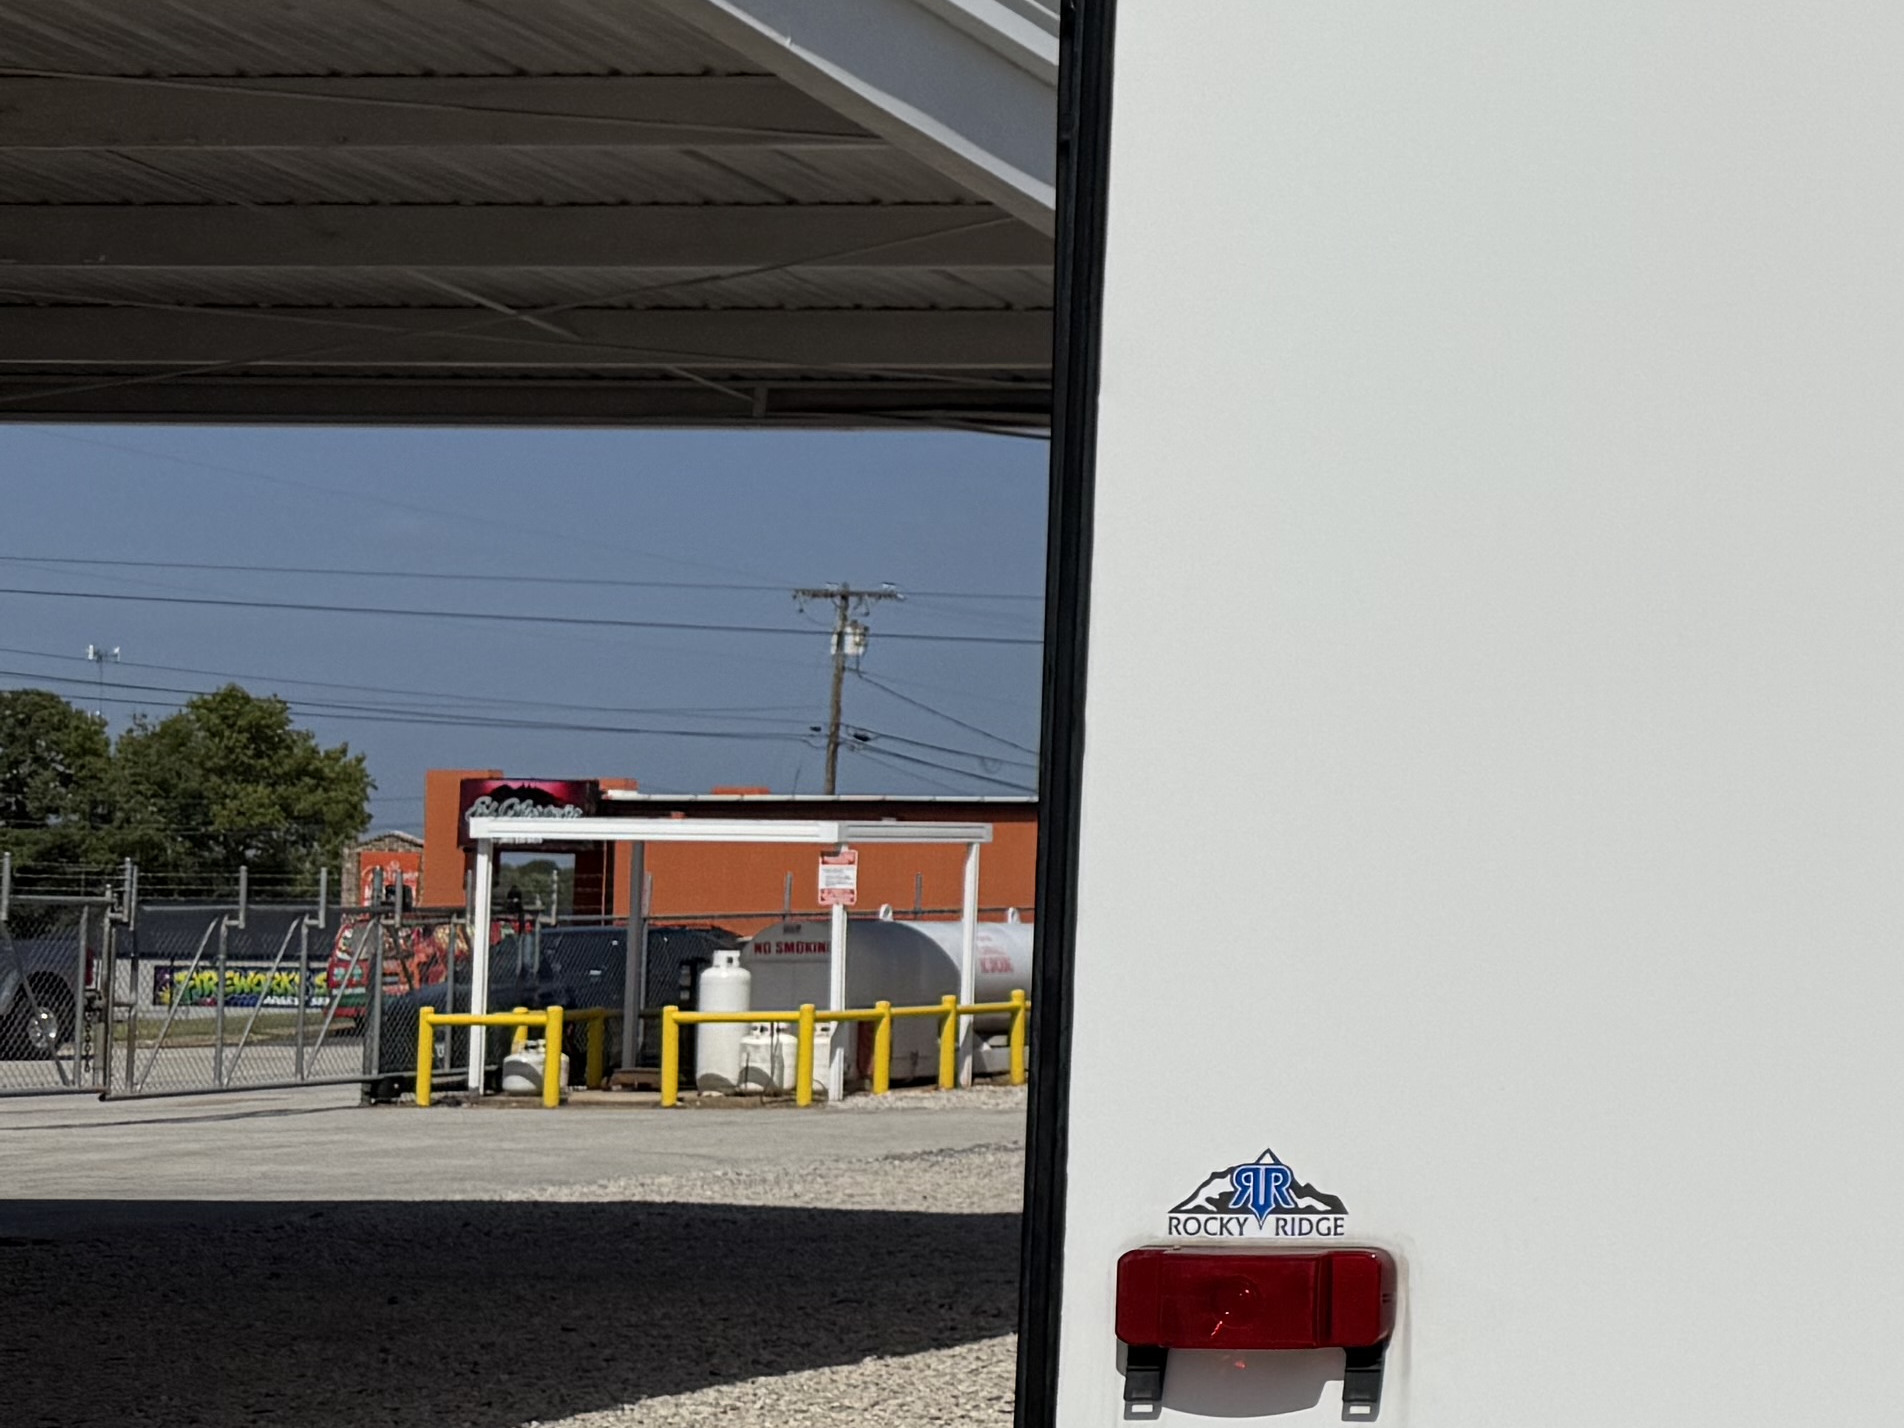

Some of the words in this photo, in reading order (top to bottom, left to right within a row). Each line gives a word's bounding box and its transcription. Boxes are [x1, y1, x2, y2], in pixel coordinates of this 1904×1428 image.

[754, 942, 771, 954] NO
[776, 941, 832, 954] SMOKIN
[1168, 1216, 1249, 1237] ROCKY
[1275, 1216, 1345, 1237] RIDGE
